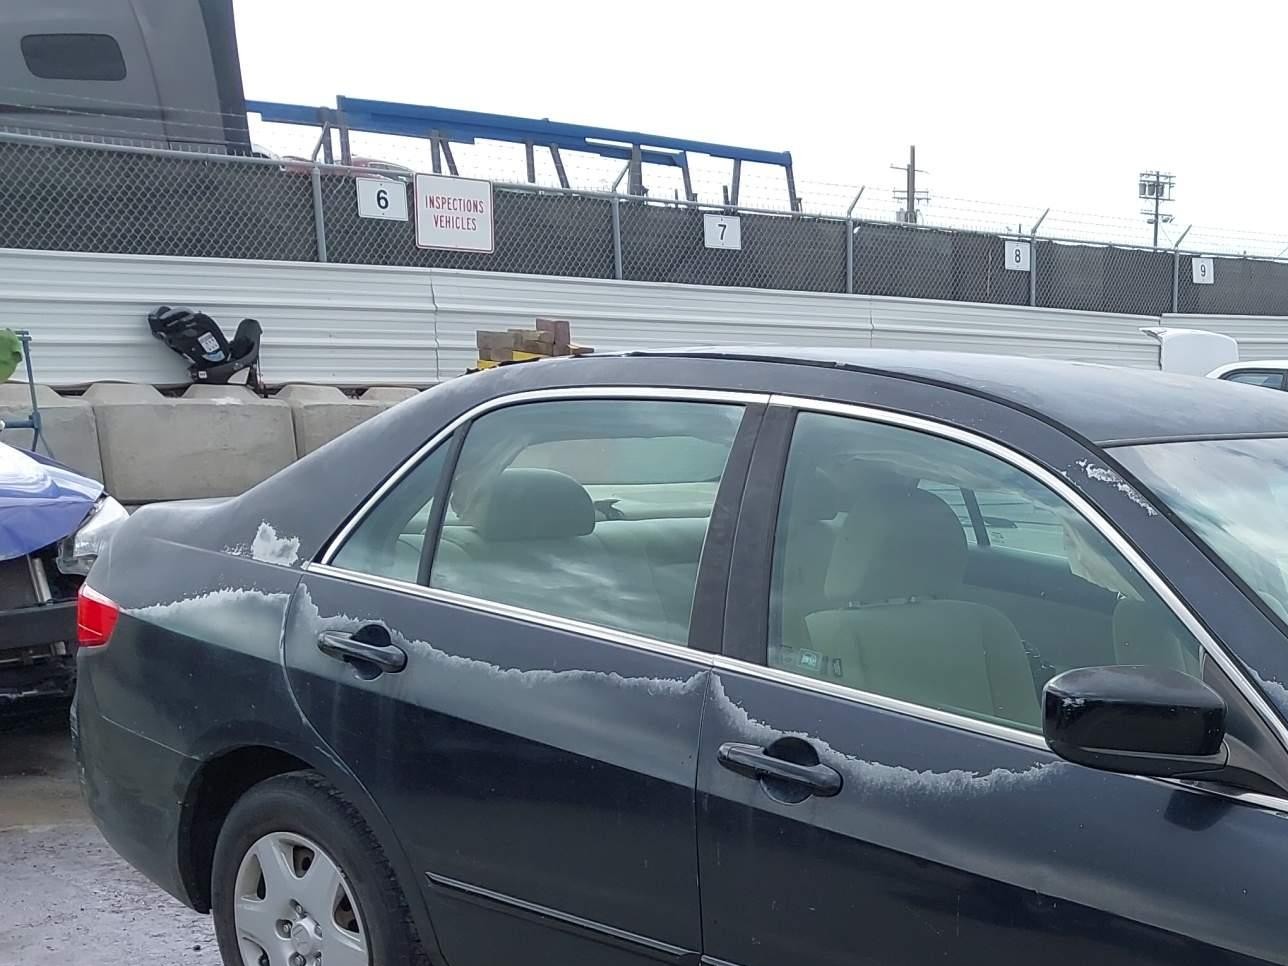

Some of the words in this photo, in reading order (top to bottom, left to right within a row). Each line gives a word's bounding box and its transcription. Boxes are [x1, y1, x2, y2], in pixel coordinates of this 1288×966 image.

[376, 189, 389, 210] 6
[425, 194, 485, 214] INSPECTIONS
[433, 213, 477, 232] VEHICLES
[717, 223, 727, 241] 7
[1014, 248, 1021, 264] 8
[1200, 263, 1206, 278] 9
